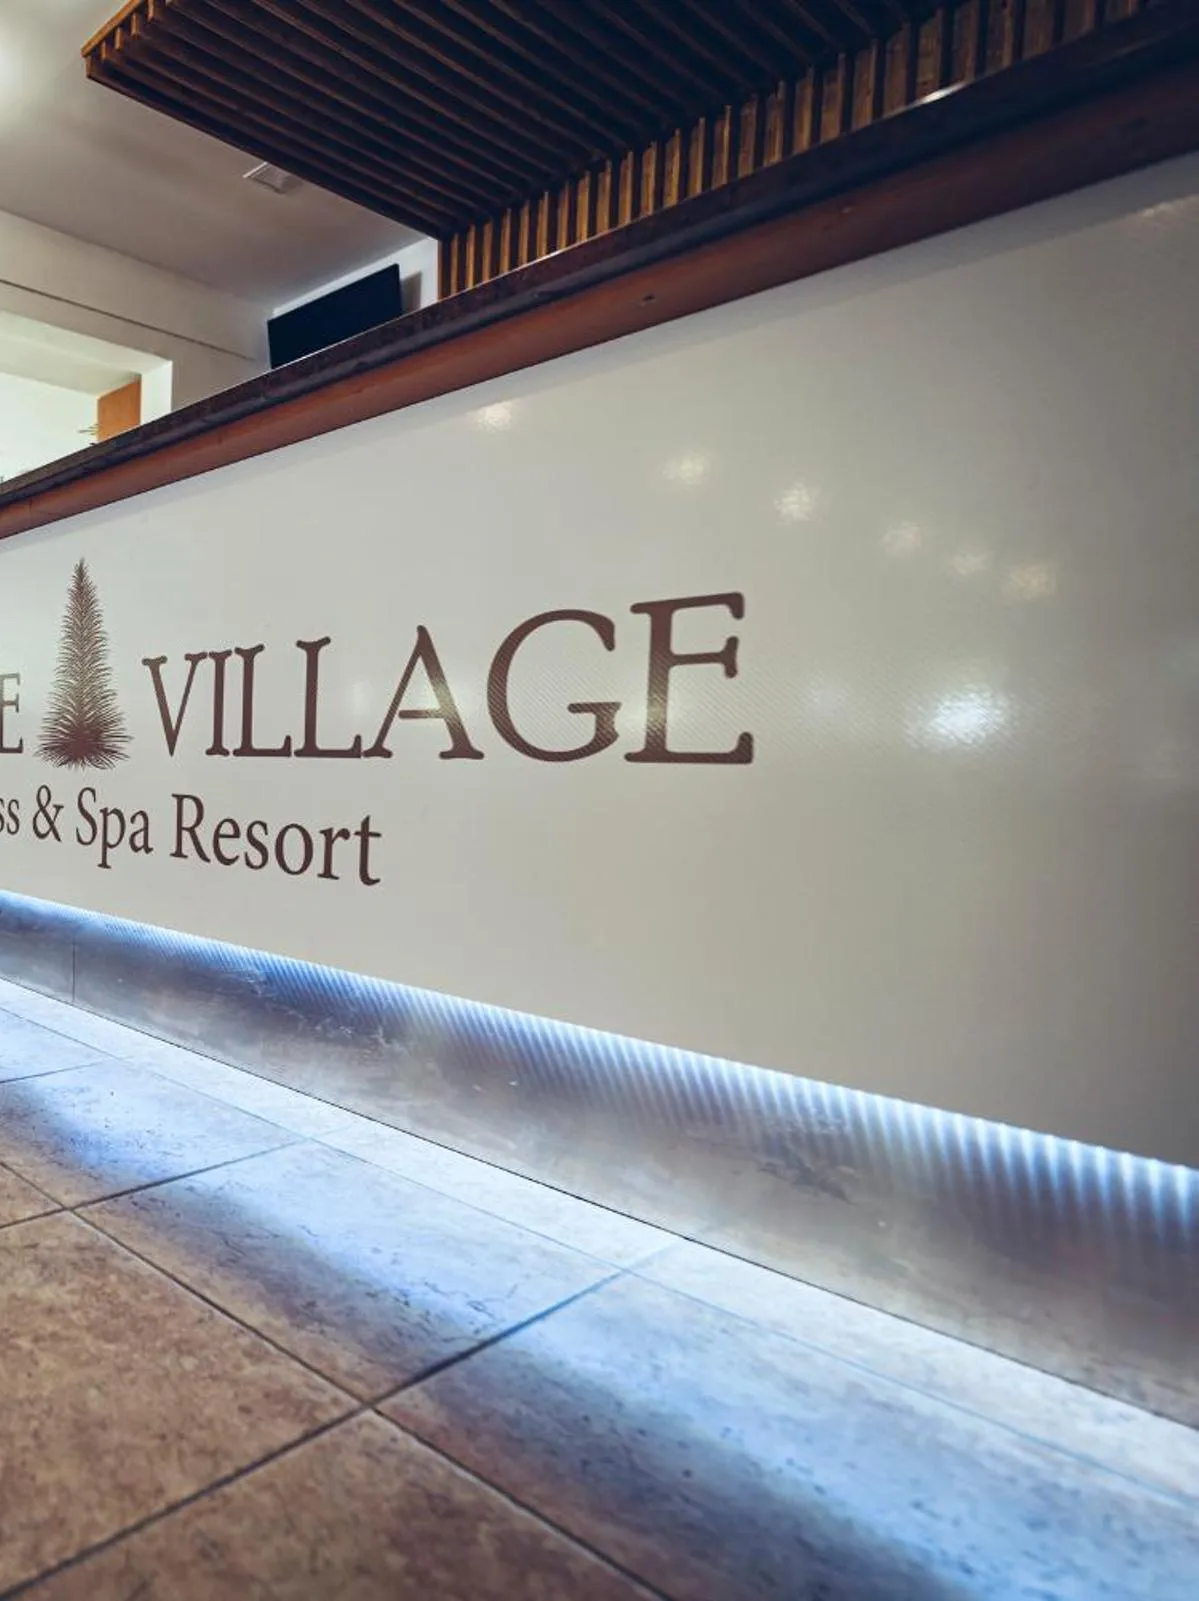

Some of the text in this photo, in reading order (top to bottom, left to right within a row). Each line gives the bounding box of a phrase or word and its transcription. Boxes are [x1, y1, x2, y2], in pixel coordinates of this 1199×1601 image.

[141, 591, 755, 766] VILLAGE
[32, 784, 63, 844] &
[76, 786, 154, 869] Spa
[169, 793, 382, 887] Resort
